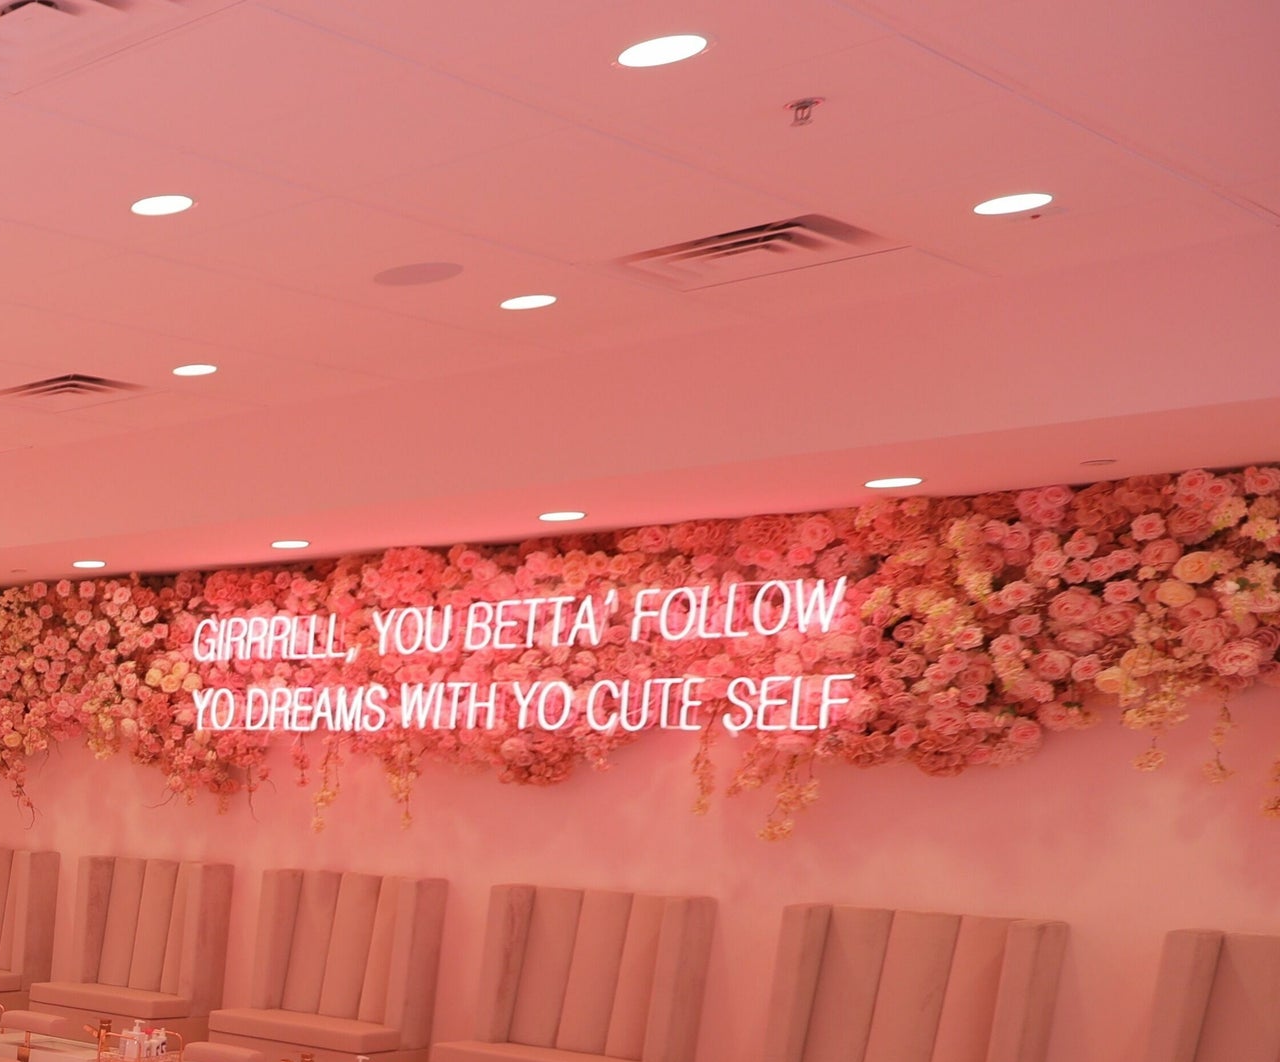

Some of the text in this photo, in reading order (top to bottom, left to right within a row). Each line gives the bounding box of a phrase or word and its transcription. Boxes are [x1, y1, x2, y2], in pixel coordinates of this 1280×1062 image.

[193, 575, 847, 663] GIRRRLLL, YOU BETTA' FOLLOW
[192, 673, 856, 732] YO DREAMS WITH YO CUTE SELF
